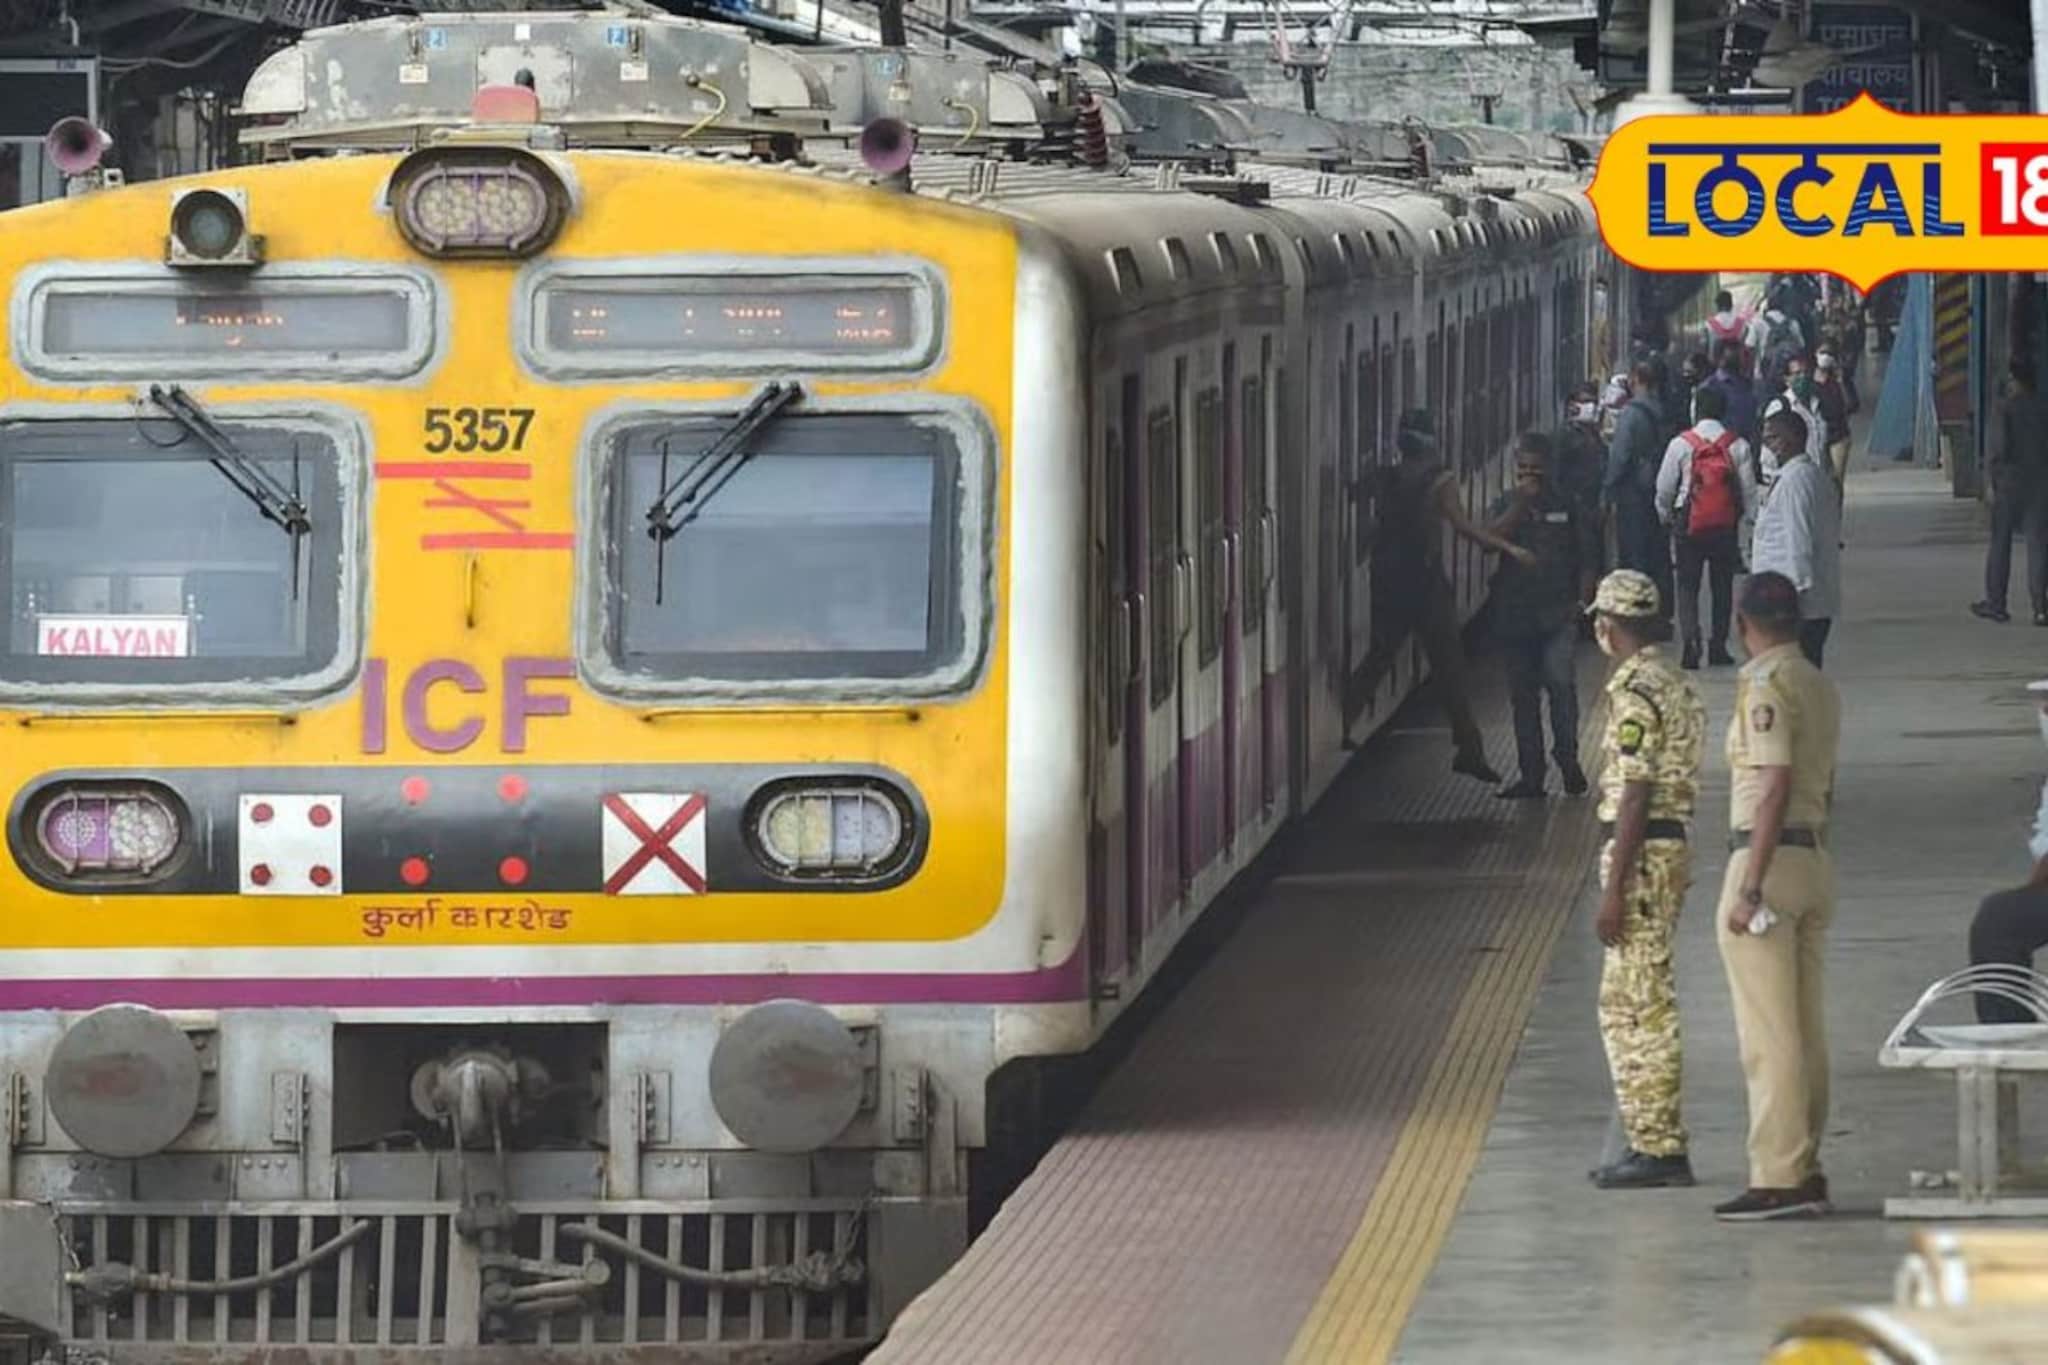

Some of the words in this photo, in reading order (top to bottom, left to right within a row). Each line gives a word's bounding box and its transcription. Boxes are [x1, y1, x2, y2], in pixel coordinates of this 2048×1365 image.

[424, 407, 535, 454] 5357
[47, 626, 177, 657] KALYAN
[361, 657, 577, 754] ICF
[362, 898, 442, 937] कुर्ला
